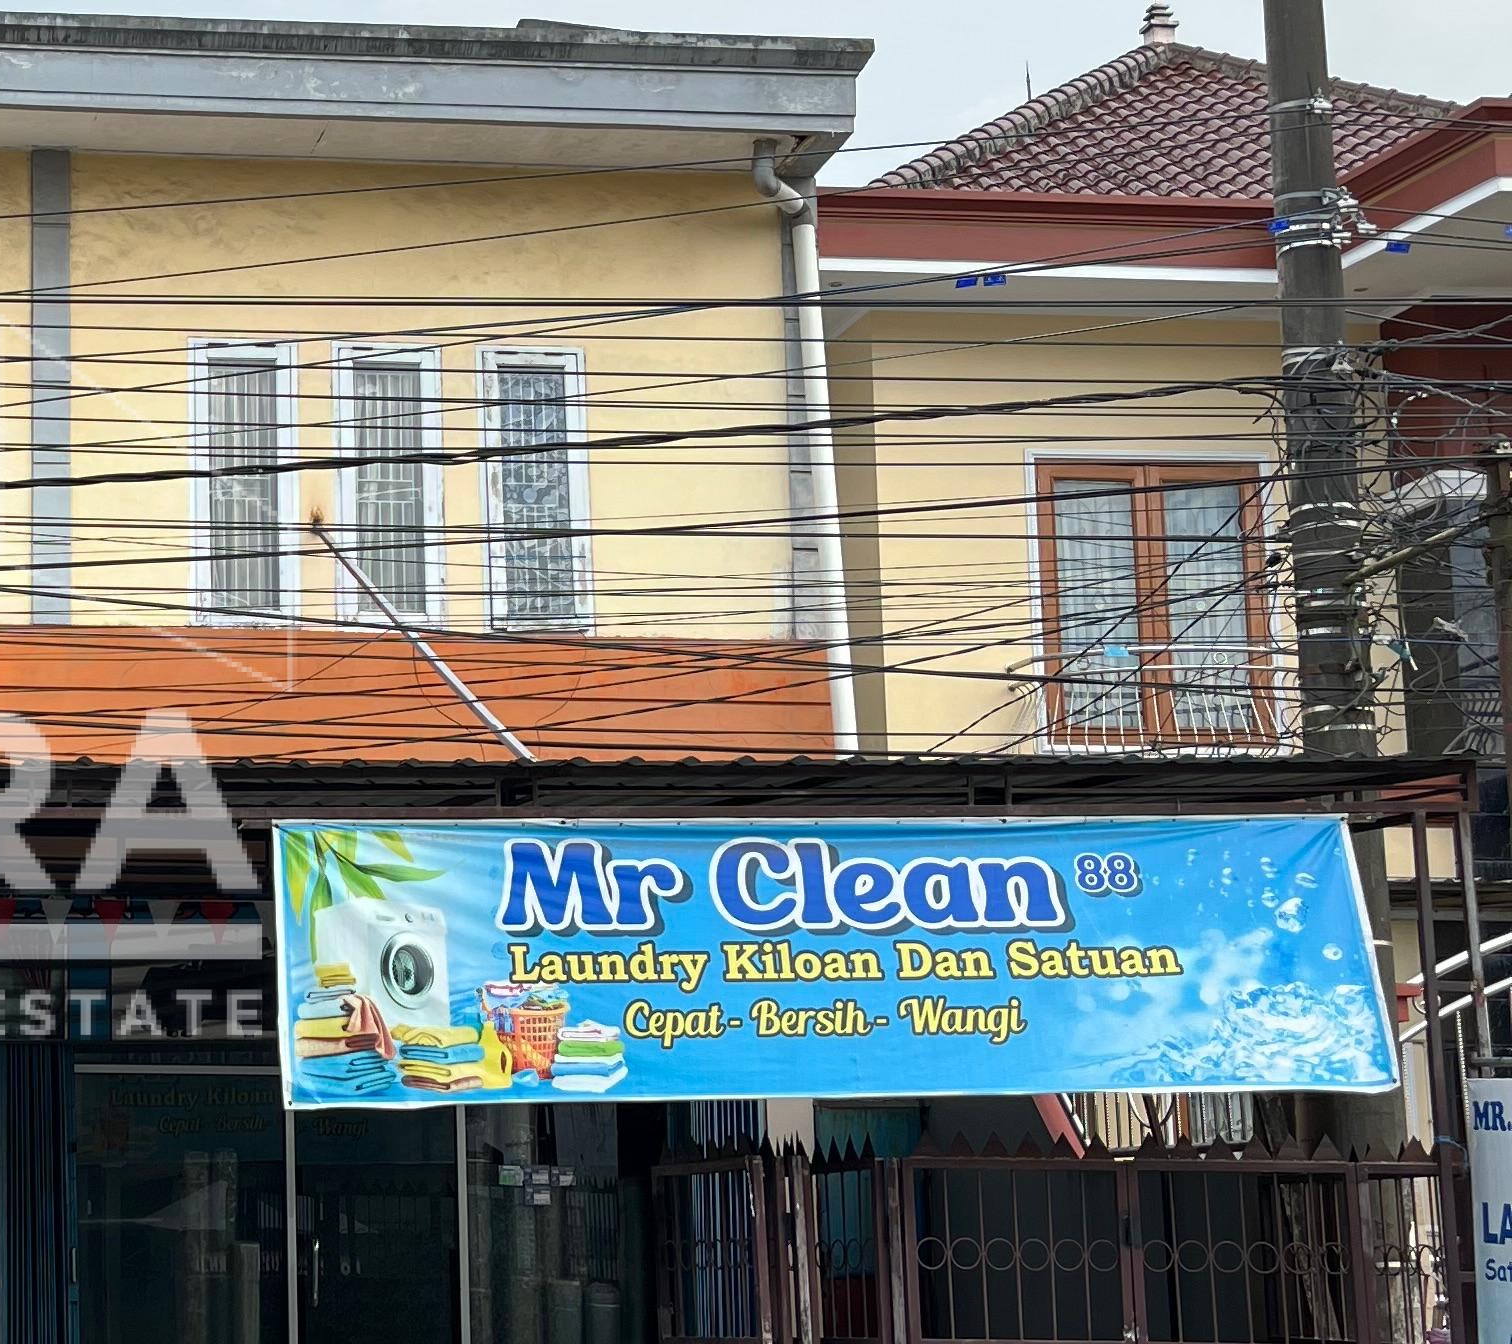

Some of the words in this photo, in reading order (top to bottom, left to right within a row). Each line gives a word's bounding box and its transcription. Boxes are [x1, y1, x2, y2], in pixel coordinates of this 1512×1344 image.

[496, 838, 686, 932] Mr
[709, 836, 1067, 931] Clean
[1074, 852, 1139, 894] 88
[508, 941, 710, 993] Laundry
[721, 940, 884, 981] Kiloan
[894, 941, 996, 980] Dan
[1007, 939, 1183, 978] Satuan
[898, 996, 1027, 1045] Wangi
